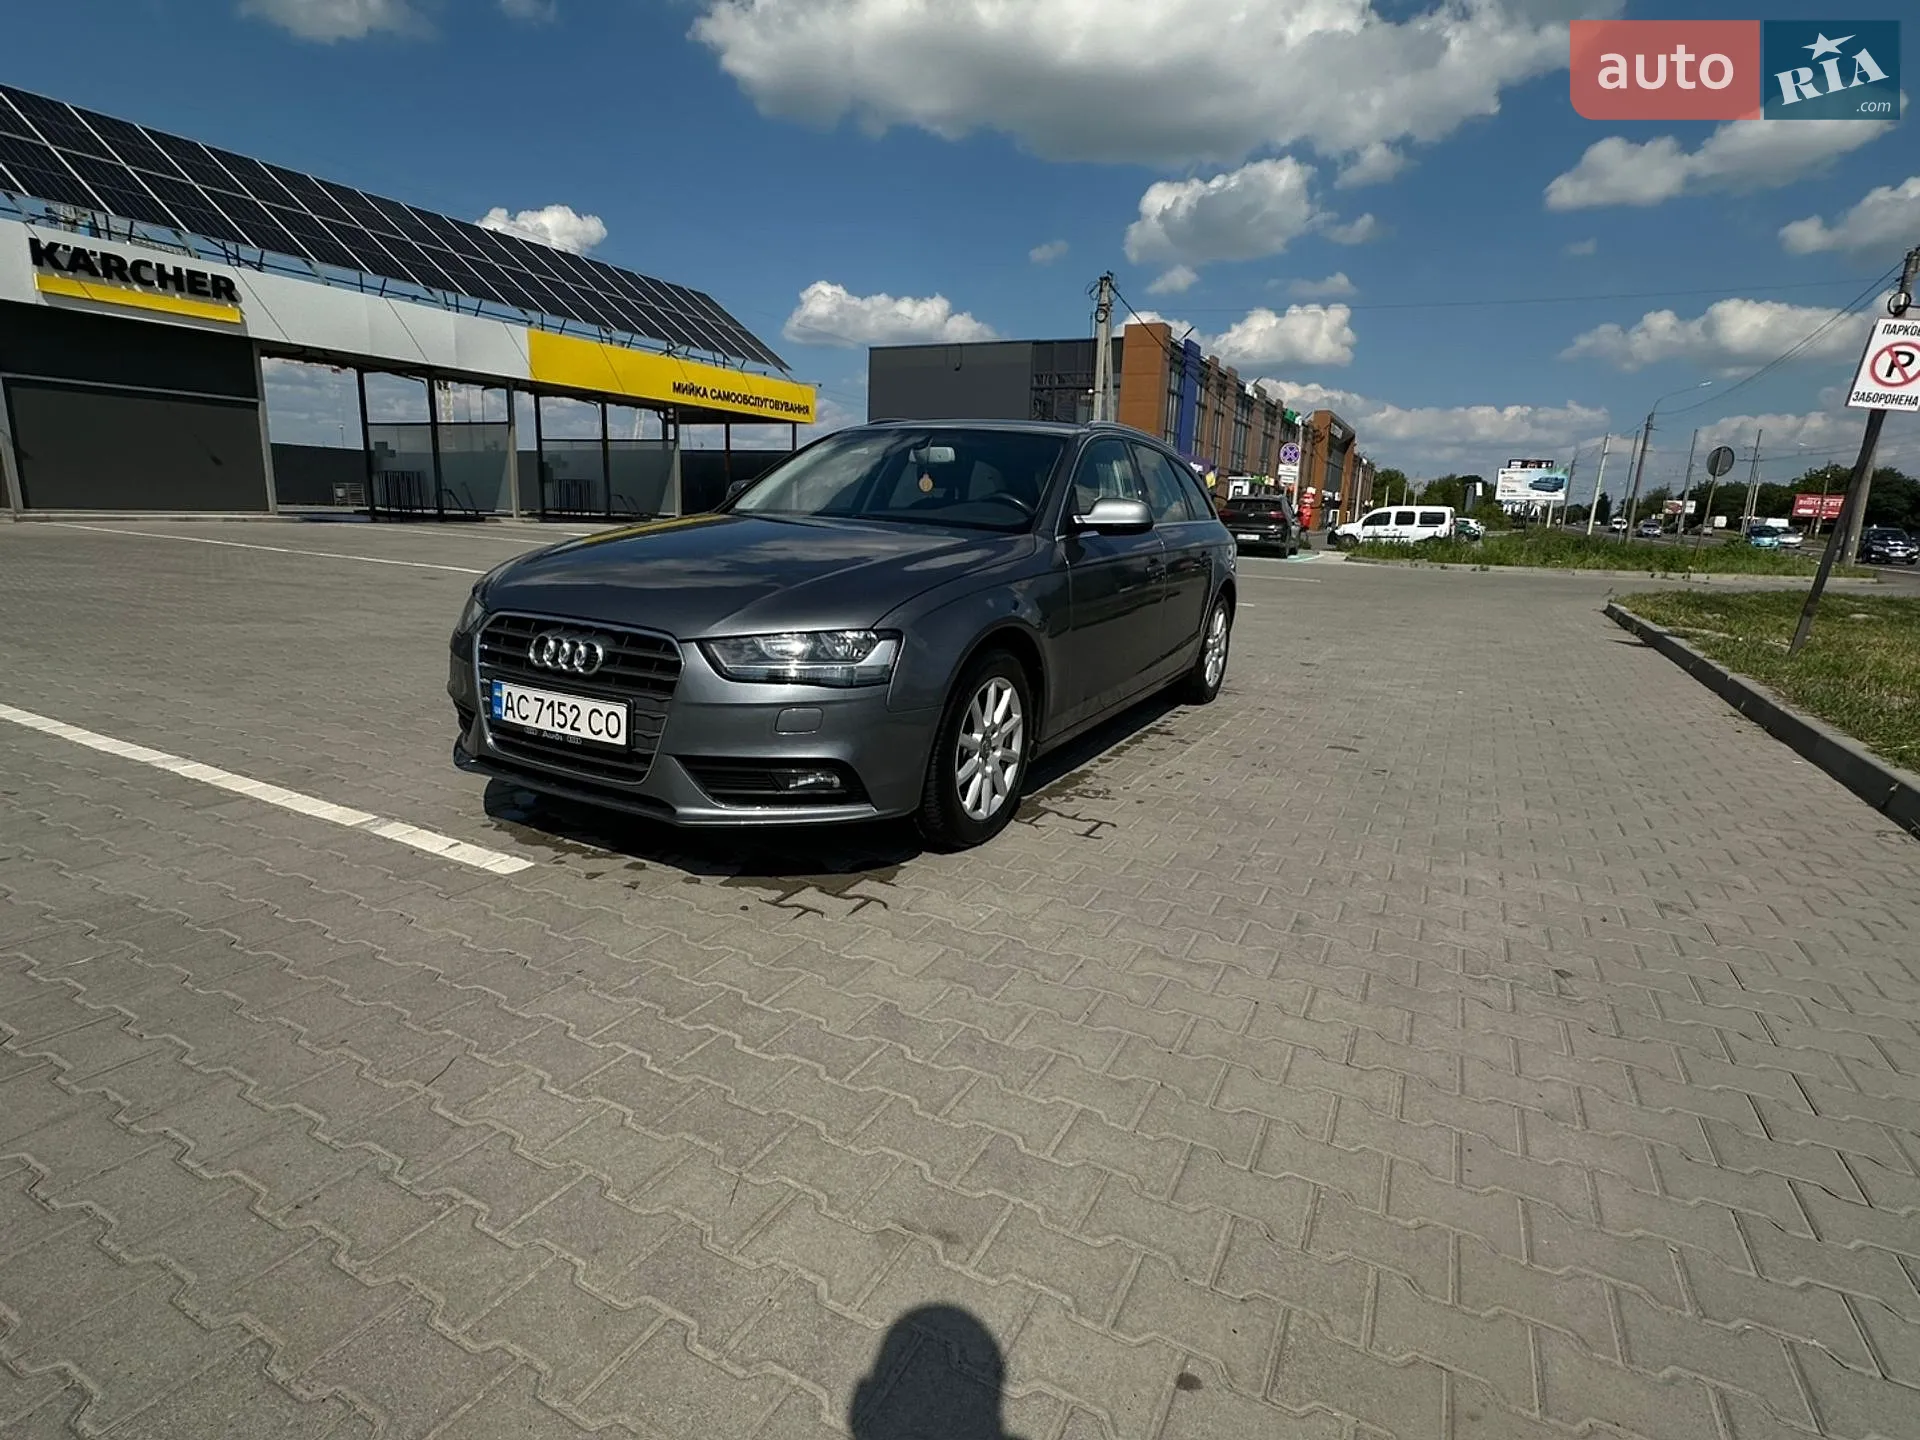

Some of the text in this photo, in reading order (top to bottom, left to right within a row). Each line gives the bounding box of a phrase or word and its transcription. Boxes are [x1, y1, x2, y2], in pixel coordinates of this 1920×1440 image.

[28, 237, 240, 302] KÄRCHER
[673, 381, 810, 415] МИЙКА САМООБСЛУГОВУВАННЯ
[1852, 390, 1919, 406] ЗАБОРОНЕНА
[504, 691, 621, 739] AC 7152 CO
